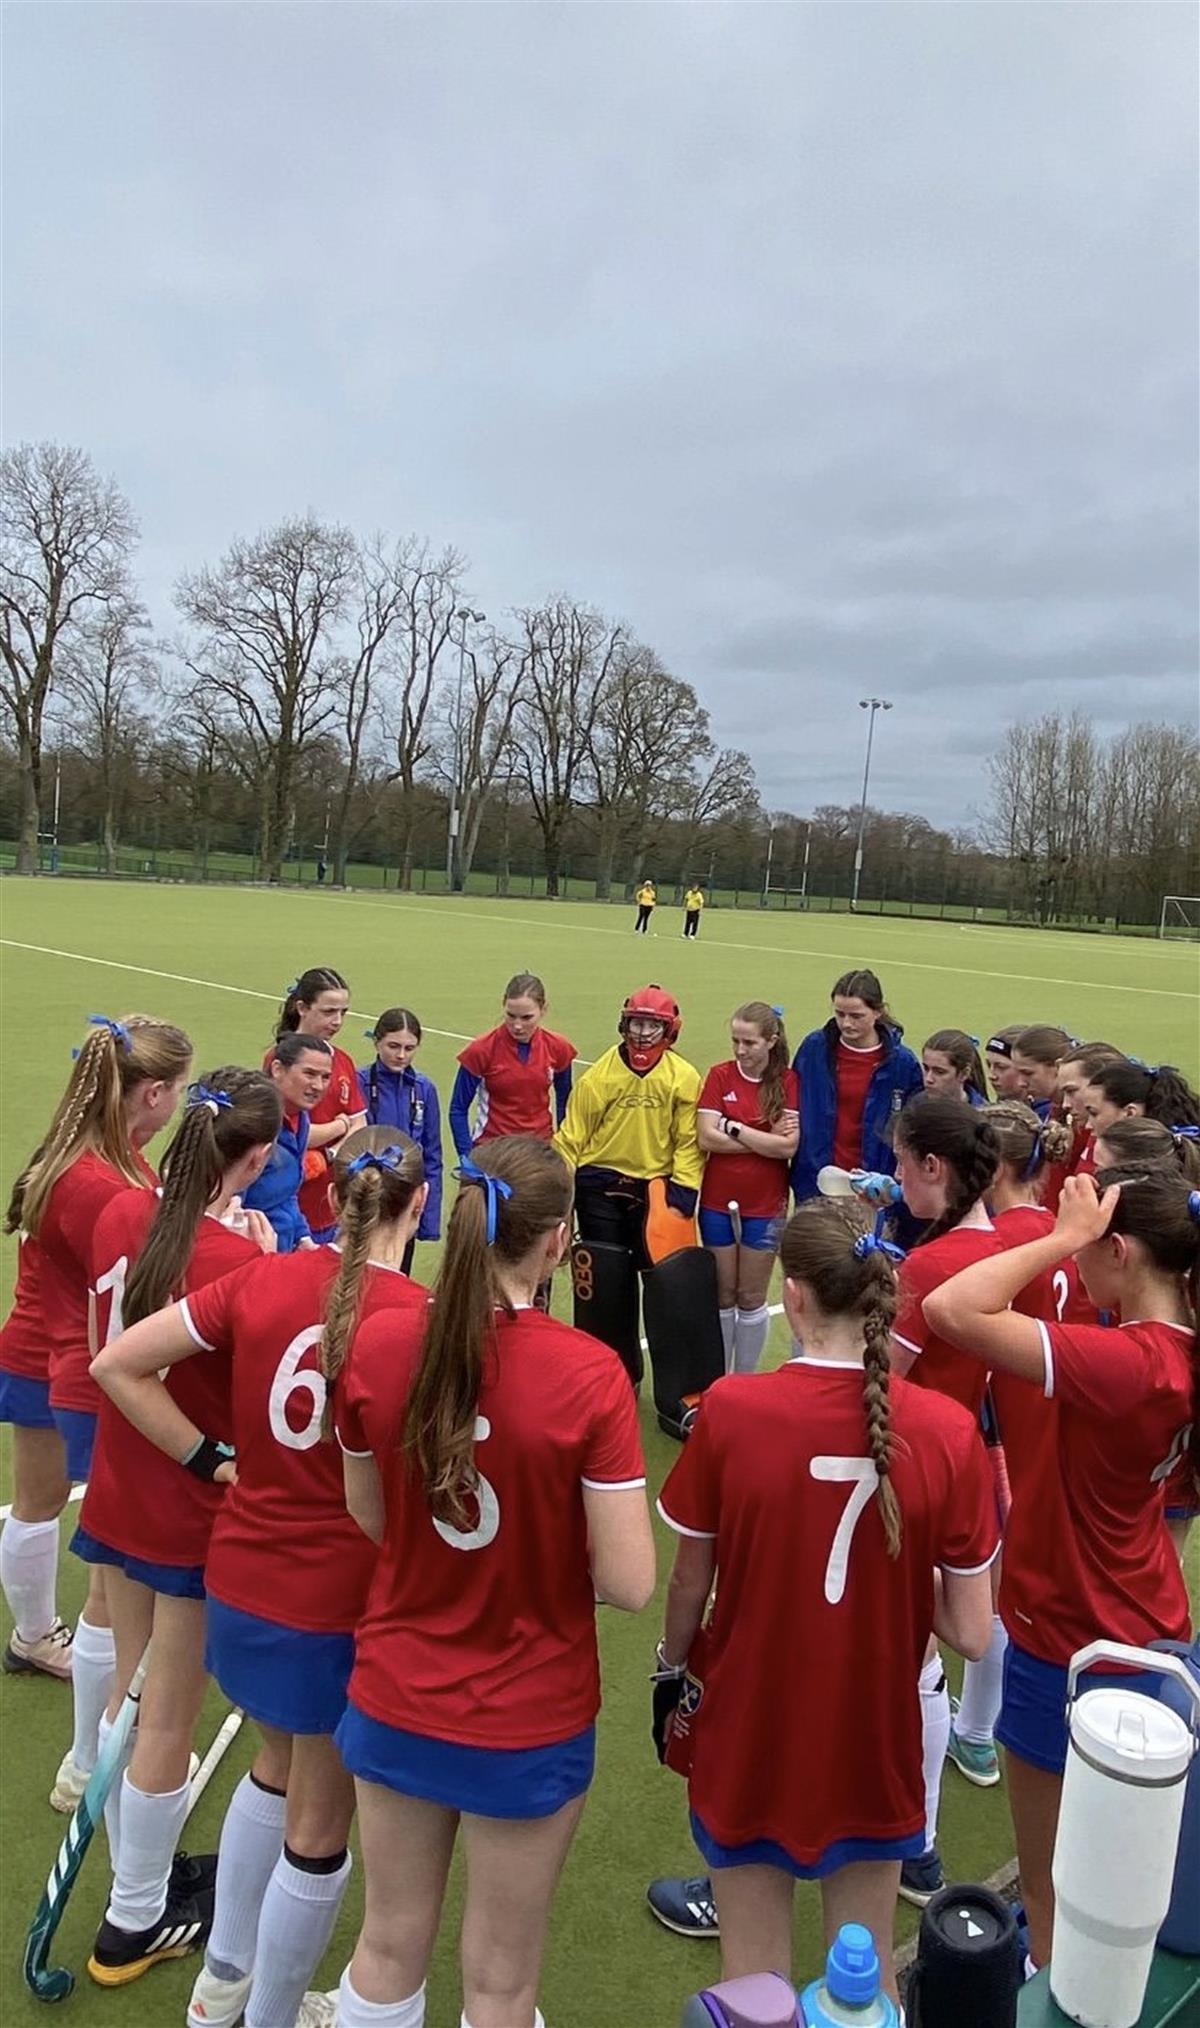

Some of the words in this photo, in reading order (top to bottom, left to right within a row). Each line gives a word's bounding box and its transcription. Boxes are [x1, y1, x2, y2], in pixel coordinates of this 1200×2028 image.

[575, 1249, 593, 1301] OBO
[268, 1323, 327, 1451] 6
[809, 1455, 880, 1605] 7
